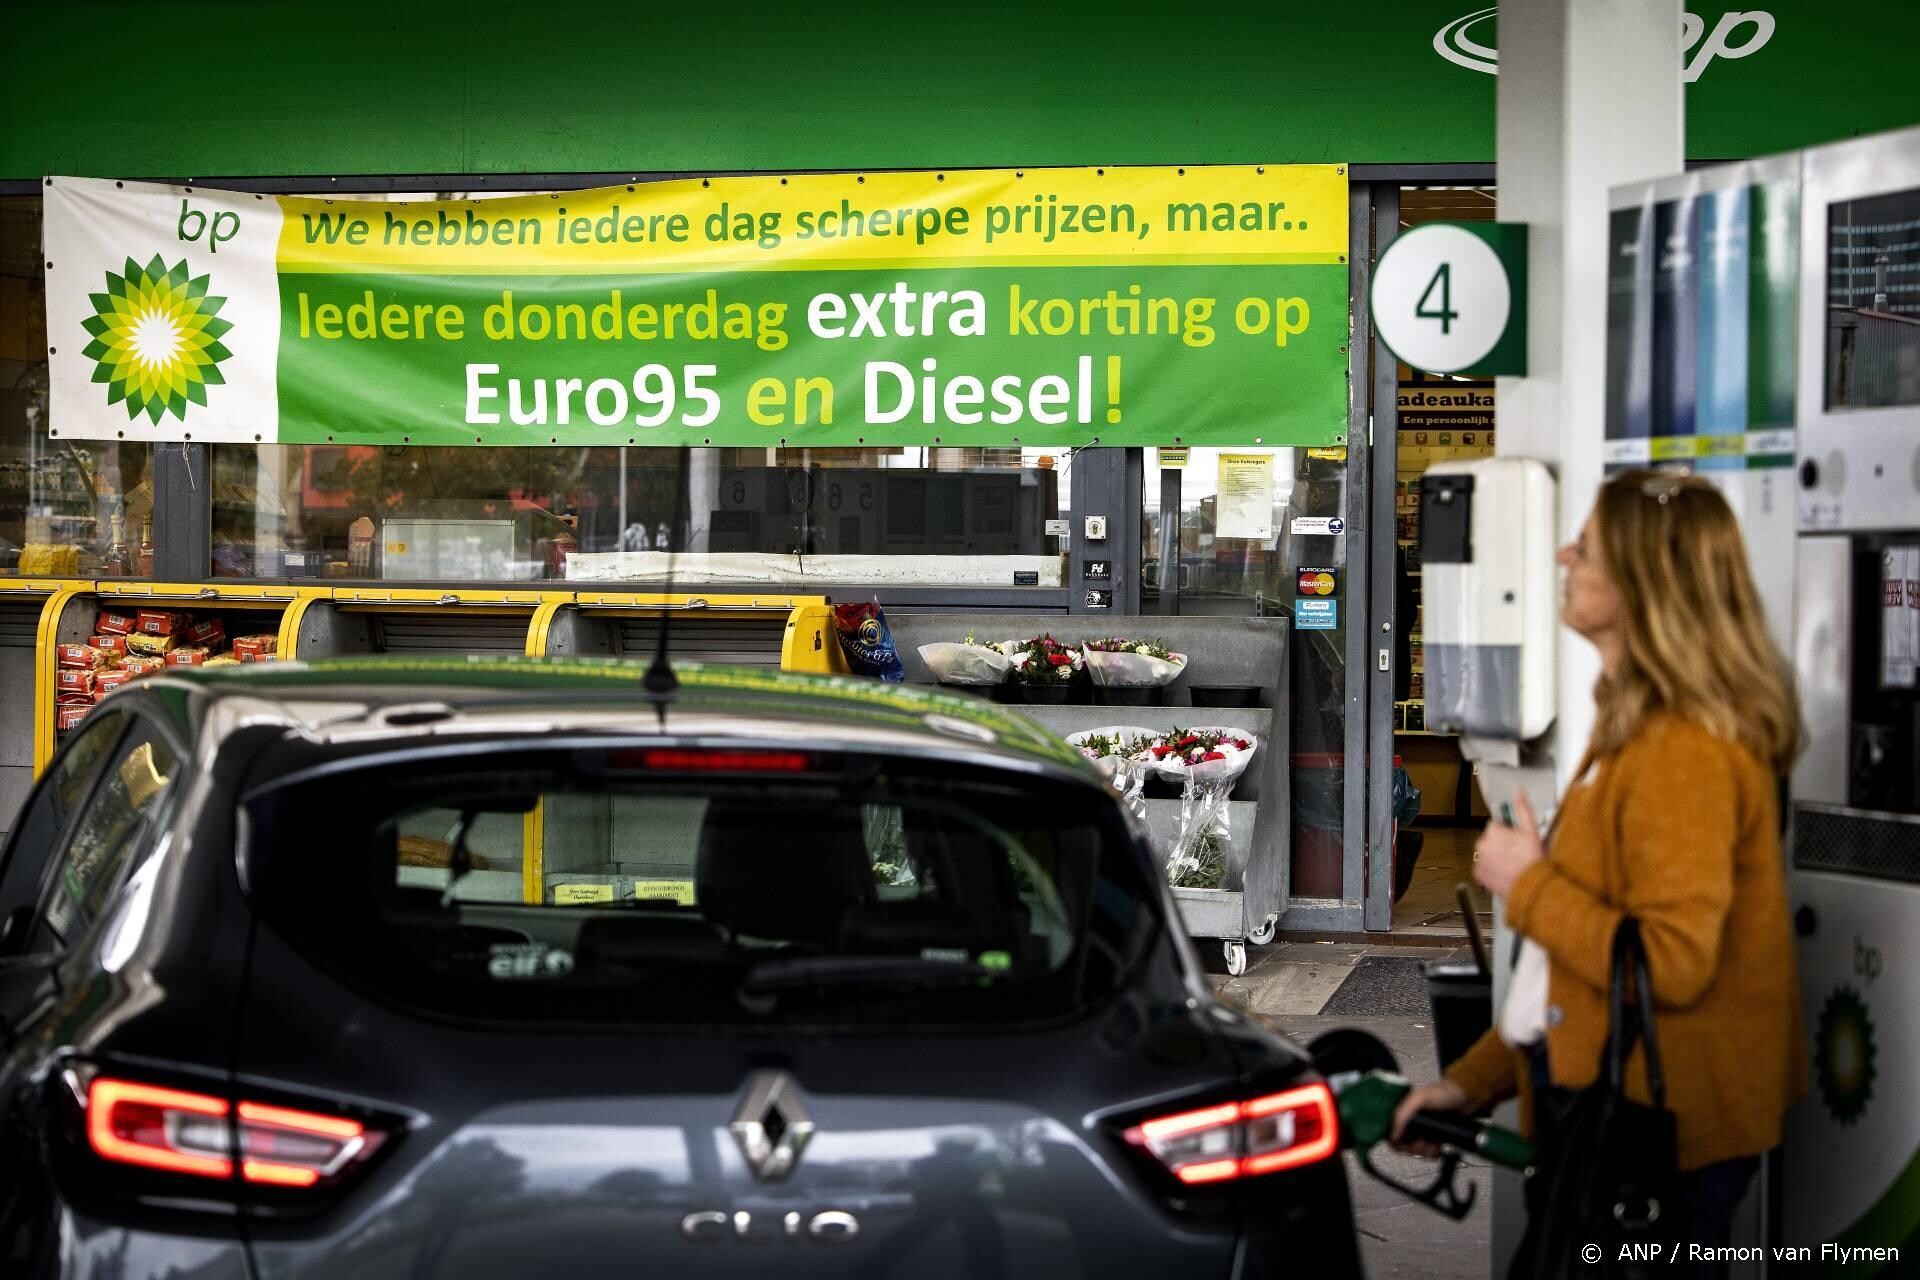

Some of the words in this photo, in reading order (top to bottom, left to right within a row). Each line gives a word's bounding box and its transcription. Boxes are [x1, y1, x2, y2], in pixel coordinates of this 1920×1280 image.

[178, 199, 240, 253] bp
[302, 211, 369, 246] We
[383, 209, 541, 247] hebben
[556, 205, 690, 245] iedere
[703, 202, 782, 249] dag
[796, 199, 969, 245] scherpe
[985, 194, 1150, 243] prijzen,
[1168, 199, 1308, 233] maar..
[298, 290, 465, 340] Iedere
[483, 288, 788, 351] donderdag
[806, 281, 986, 339] extra
[1008, 284, 1217, 347] korting
[1235, 294, 1310, 347] op
[1416, 263, 1458, 335] 4
[465, 363, 721, 427] Euro95
[746, 377, 835, 426] en
[863, 356, 1123, 425] Diesel!
[1398, 392, 1495, 406] adeauka
[1403, 416, 1424, 424] Een
[1426, 416, 1489, 426] persoonlijk
[681, 1210, 860, 1241] CLIO
